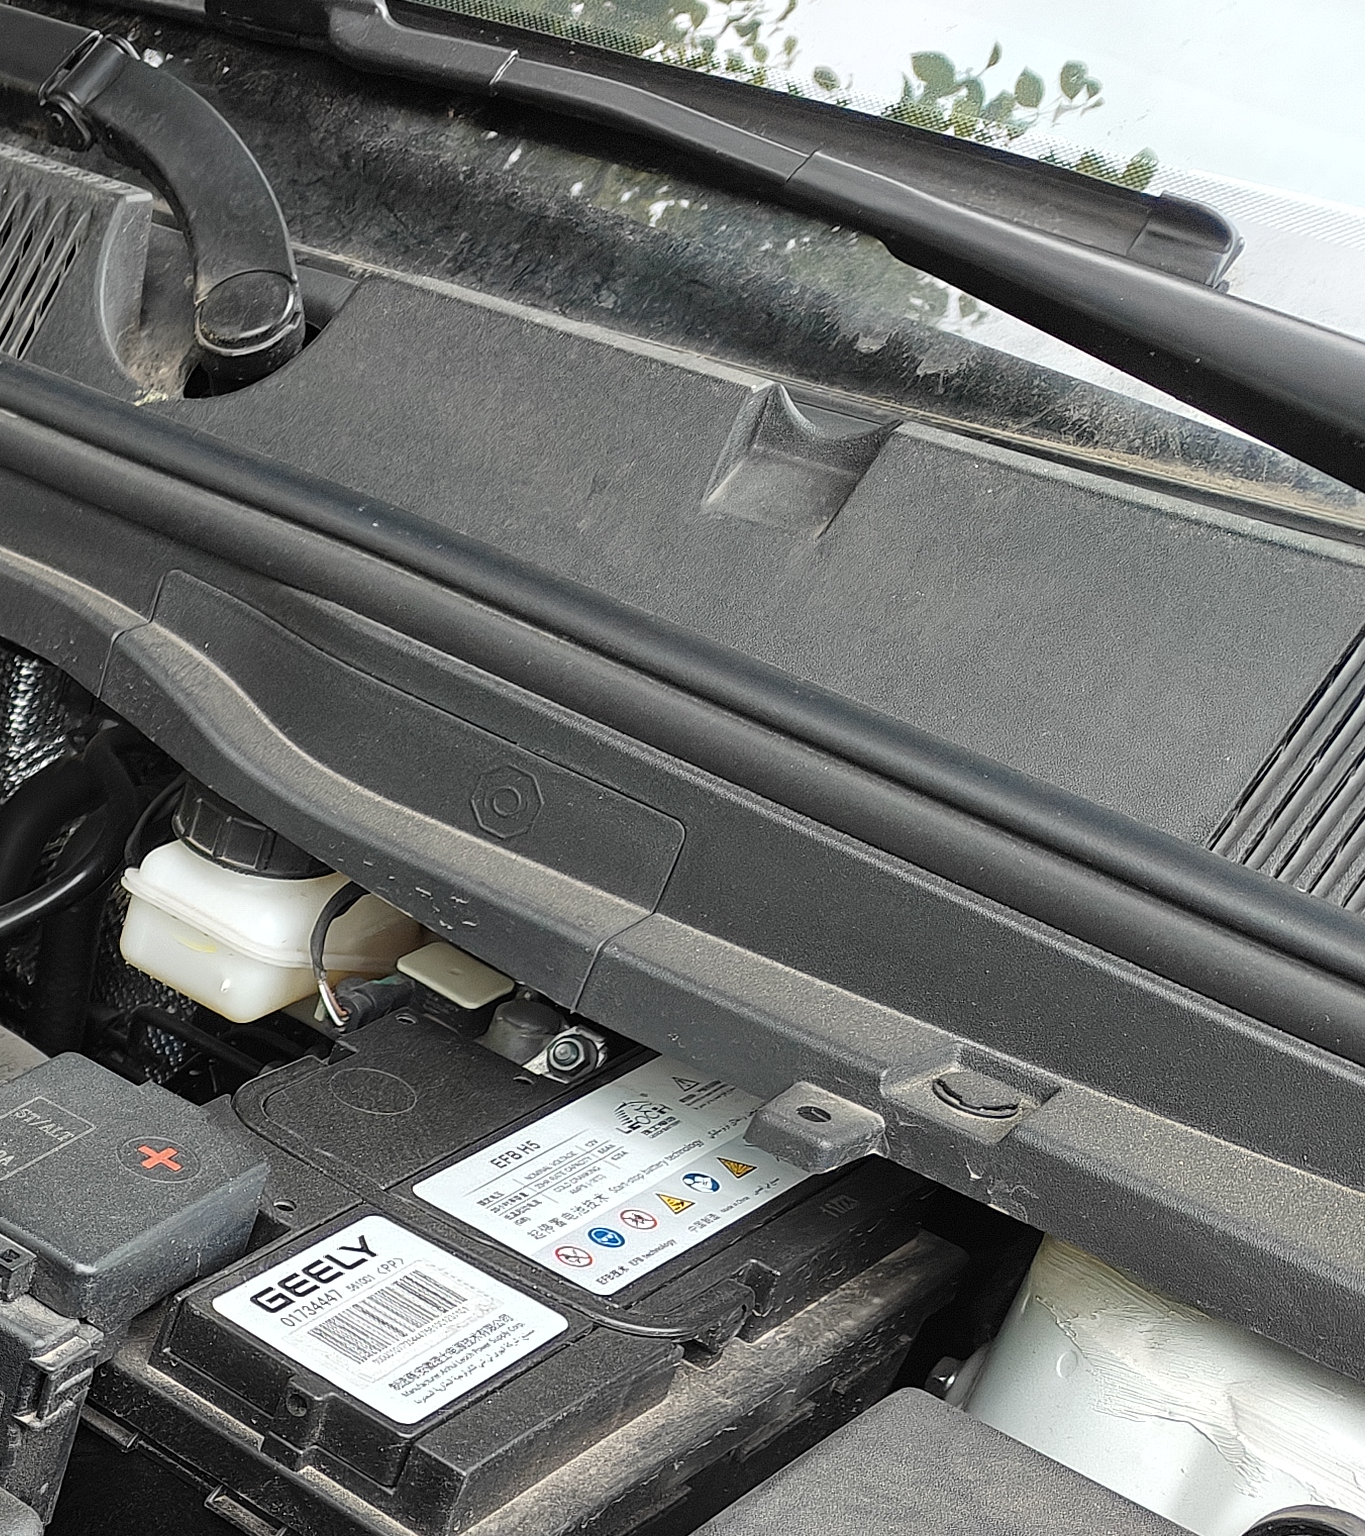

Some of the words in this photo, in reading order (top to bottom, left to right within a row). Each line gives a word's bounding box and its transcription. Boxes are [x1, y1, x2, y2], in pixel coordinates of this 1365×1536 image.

[490, 1150, 523, 1169] EFB
[517, 1140, 541, 1155] H5
[250, 1235, 378, 1313] GEELY
[280, 1289, 343, 1327] 01734447
